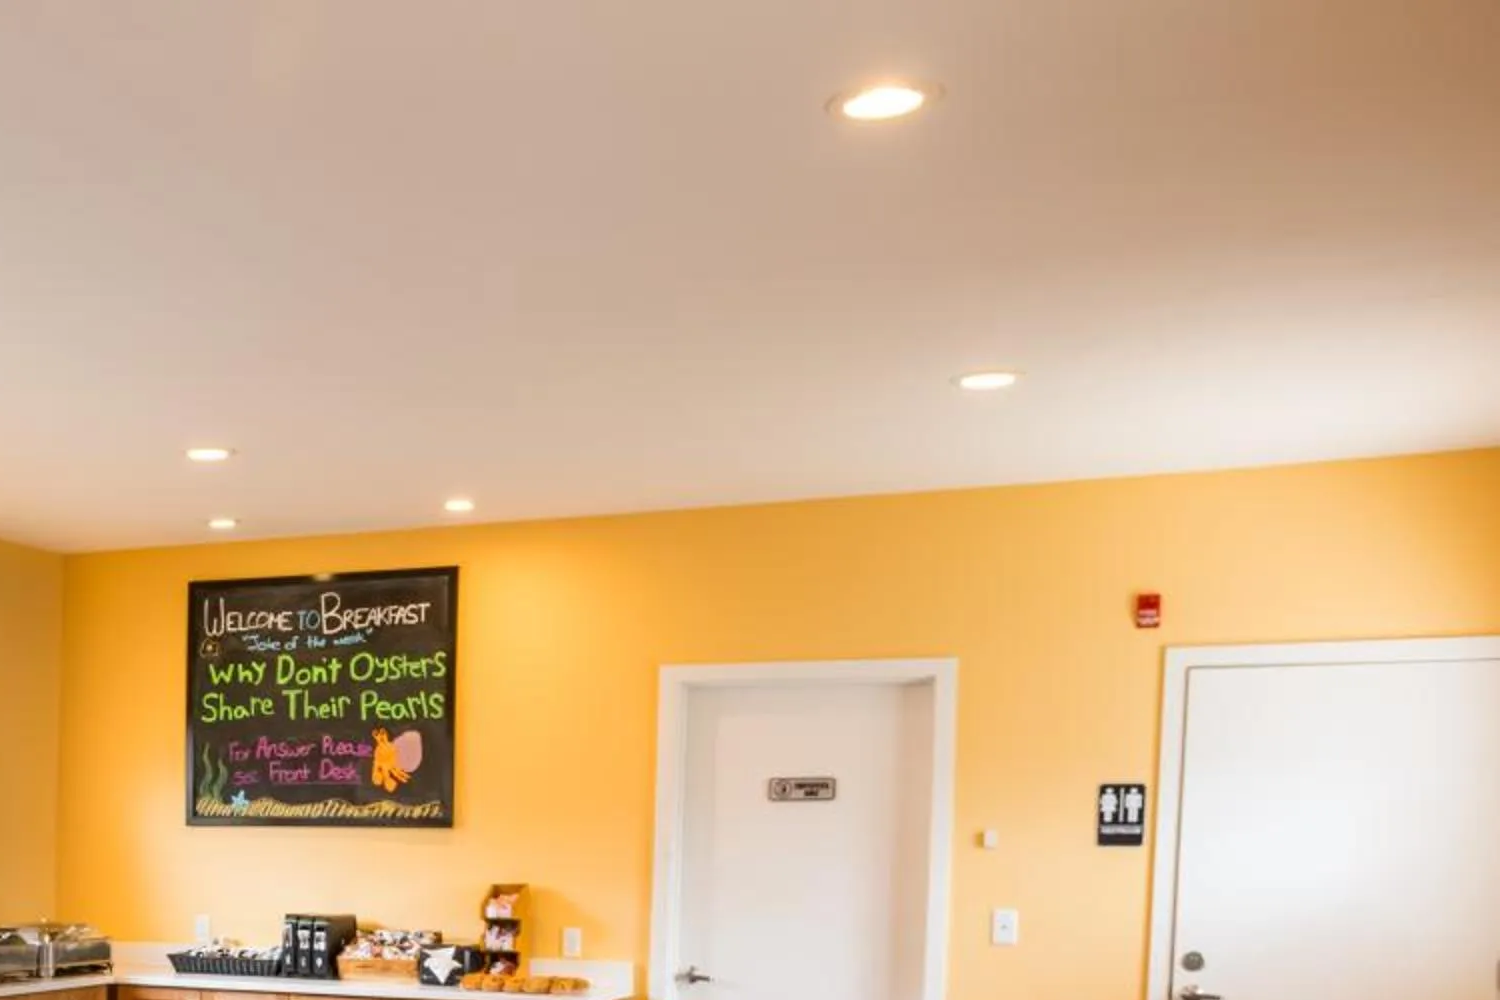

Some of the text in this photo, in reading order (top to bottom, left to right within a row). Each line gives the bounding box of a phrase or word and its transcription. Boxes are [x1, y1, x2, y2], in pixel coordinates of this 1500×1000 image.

[297, 609, 319, 631] TO
[284, 635, 299, 650] of
[276, 654, 342, 685] Don't
[349, 651, 447, 683] Oysters
[201, 689, 445, 722] Share Their Pearls
[229, 741, 251, 763] For
[255, 735, 316, 759] Answer
[269, 760, 310, 782] Front
[319, 758, 358, 781] Desk
